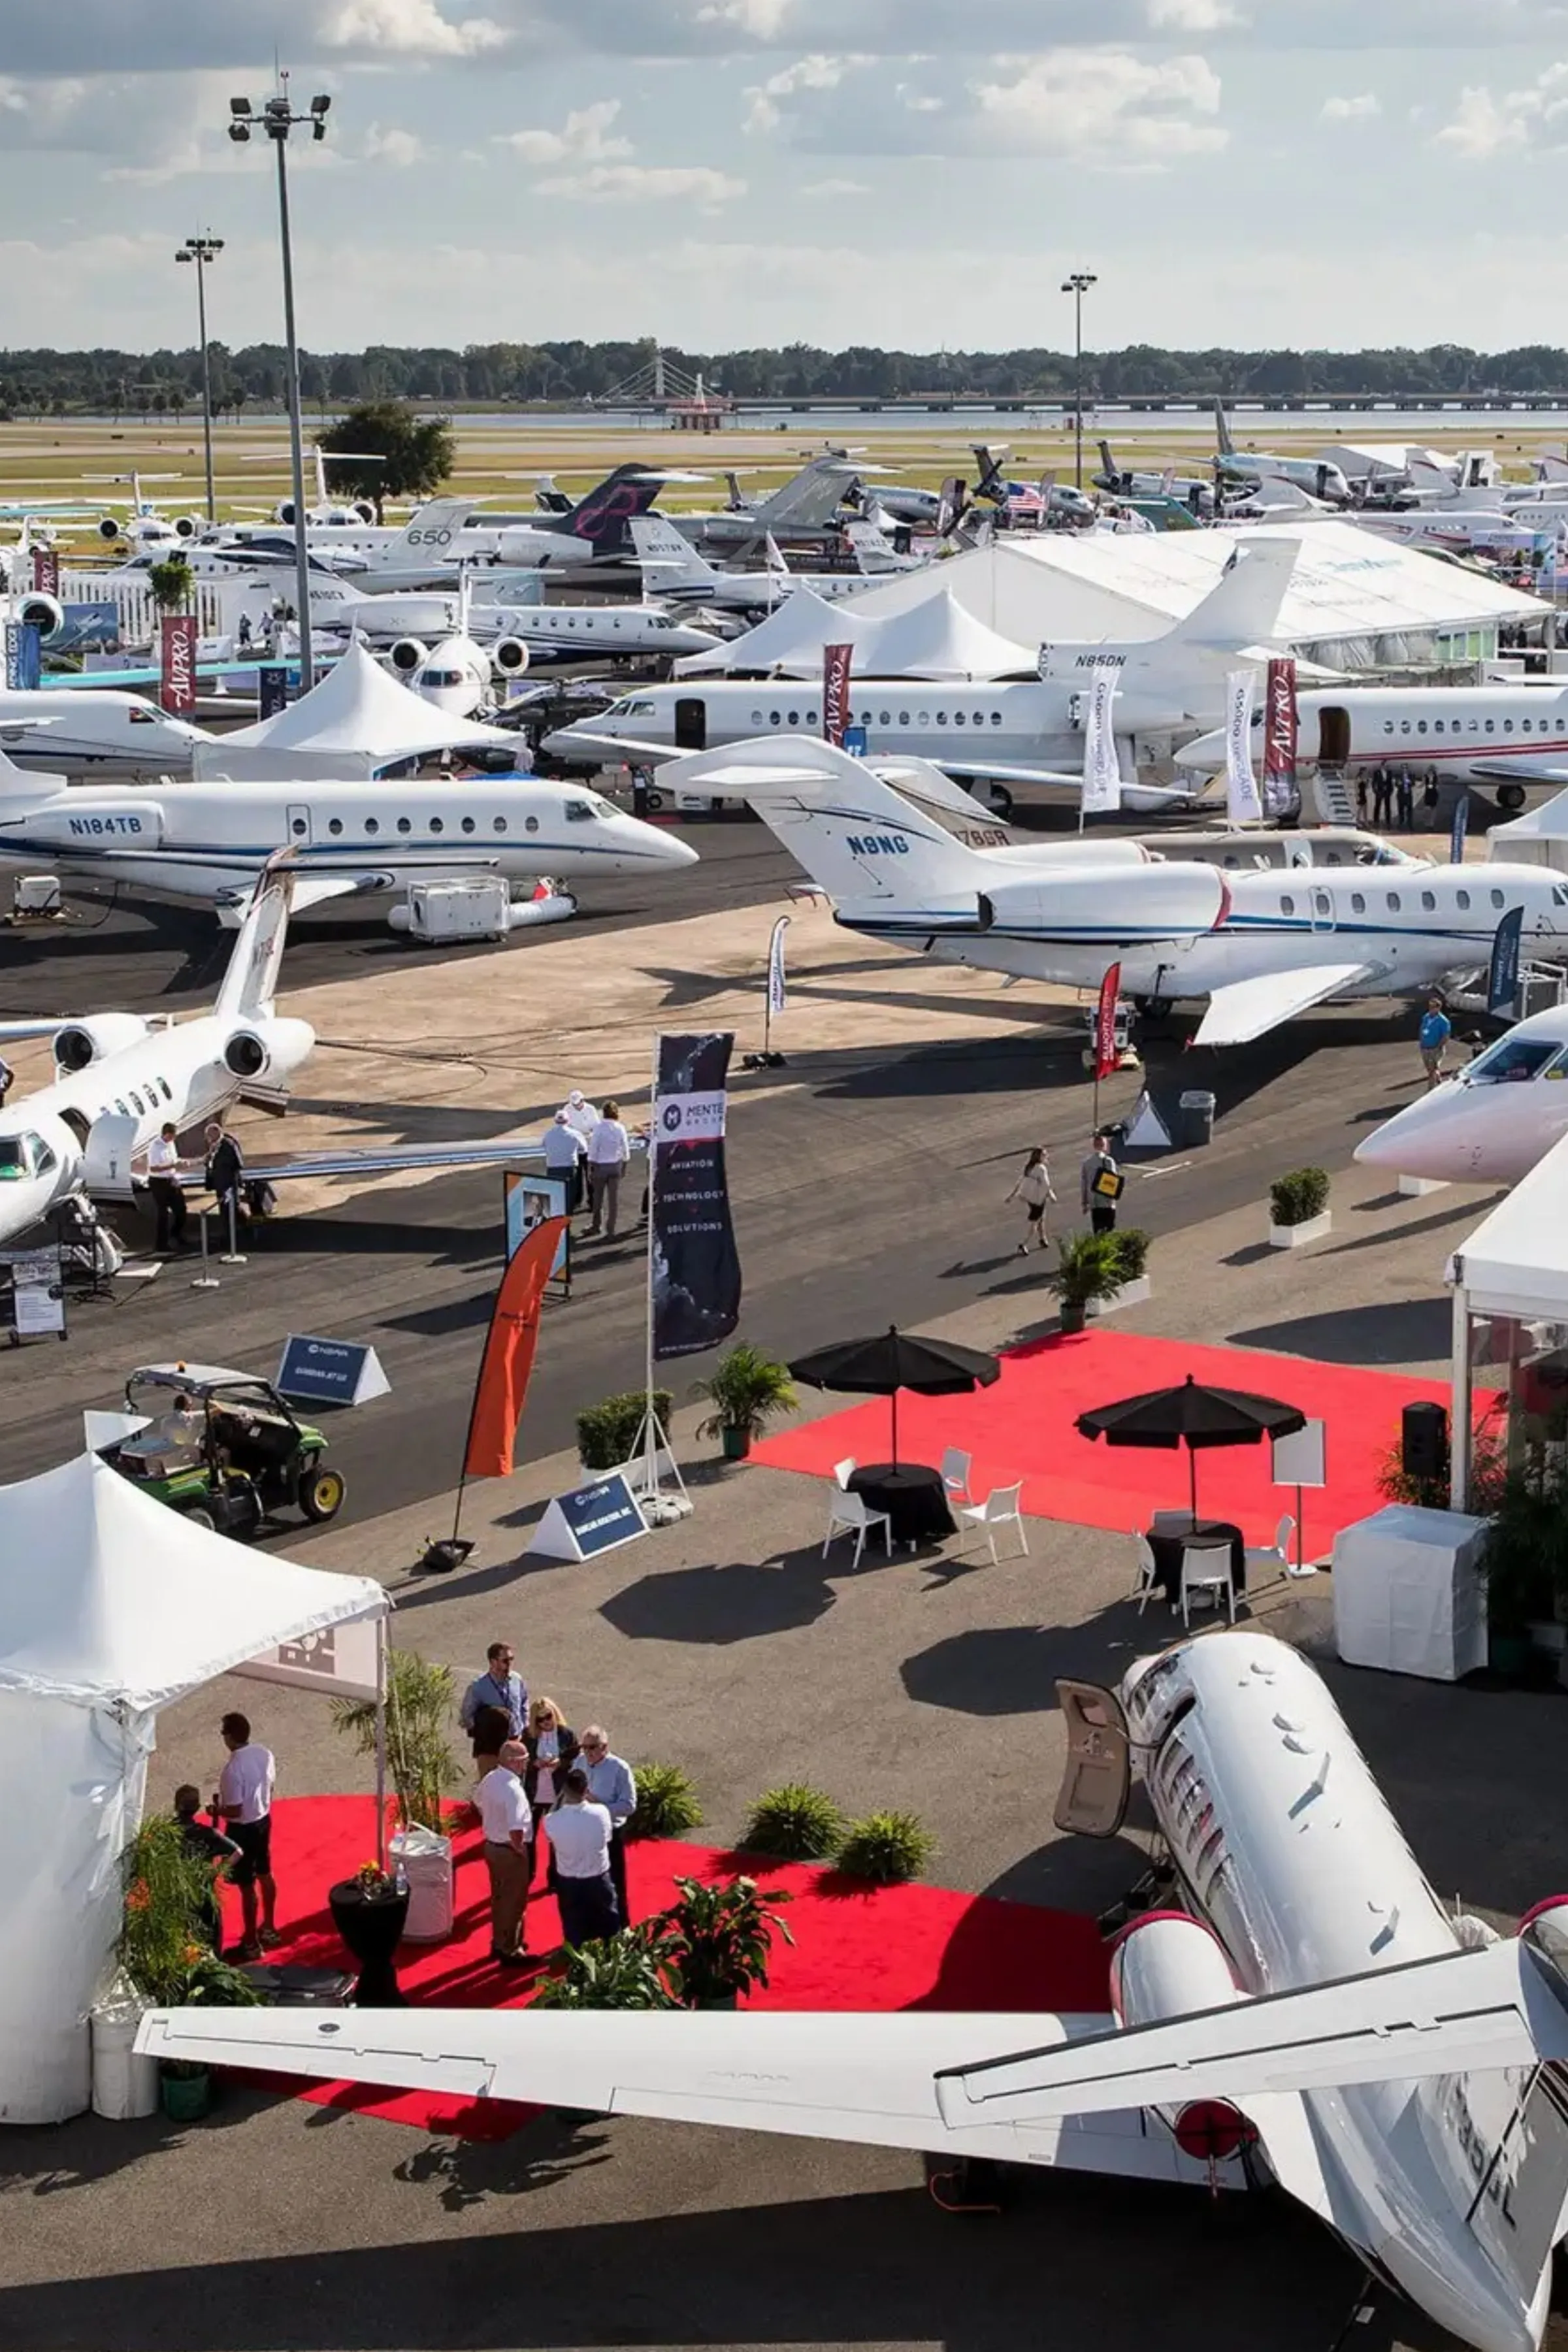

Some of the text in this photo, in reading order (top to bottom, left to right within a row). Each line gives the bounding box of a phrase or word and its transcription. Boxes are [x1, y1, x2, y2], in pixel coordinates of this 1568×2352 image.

[408, 530, 452, 546] 650
[168, 630, 191, 708] AVPRO
[826, 661, 845, 745] AVPRO
[1271, 675, 1292, 768] AVPRO
[69, 817, 142, 835] N184TB
[686, 1103, 724, 1117] MENTE
[670, 1159, 714, 1170] AVIATION
[662, 1190, 724, 1203] TECHNOLOGY
[666, 1221, 723, 1234] SOLUTIONS
